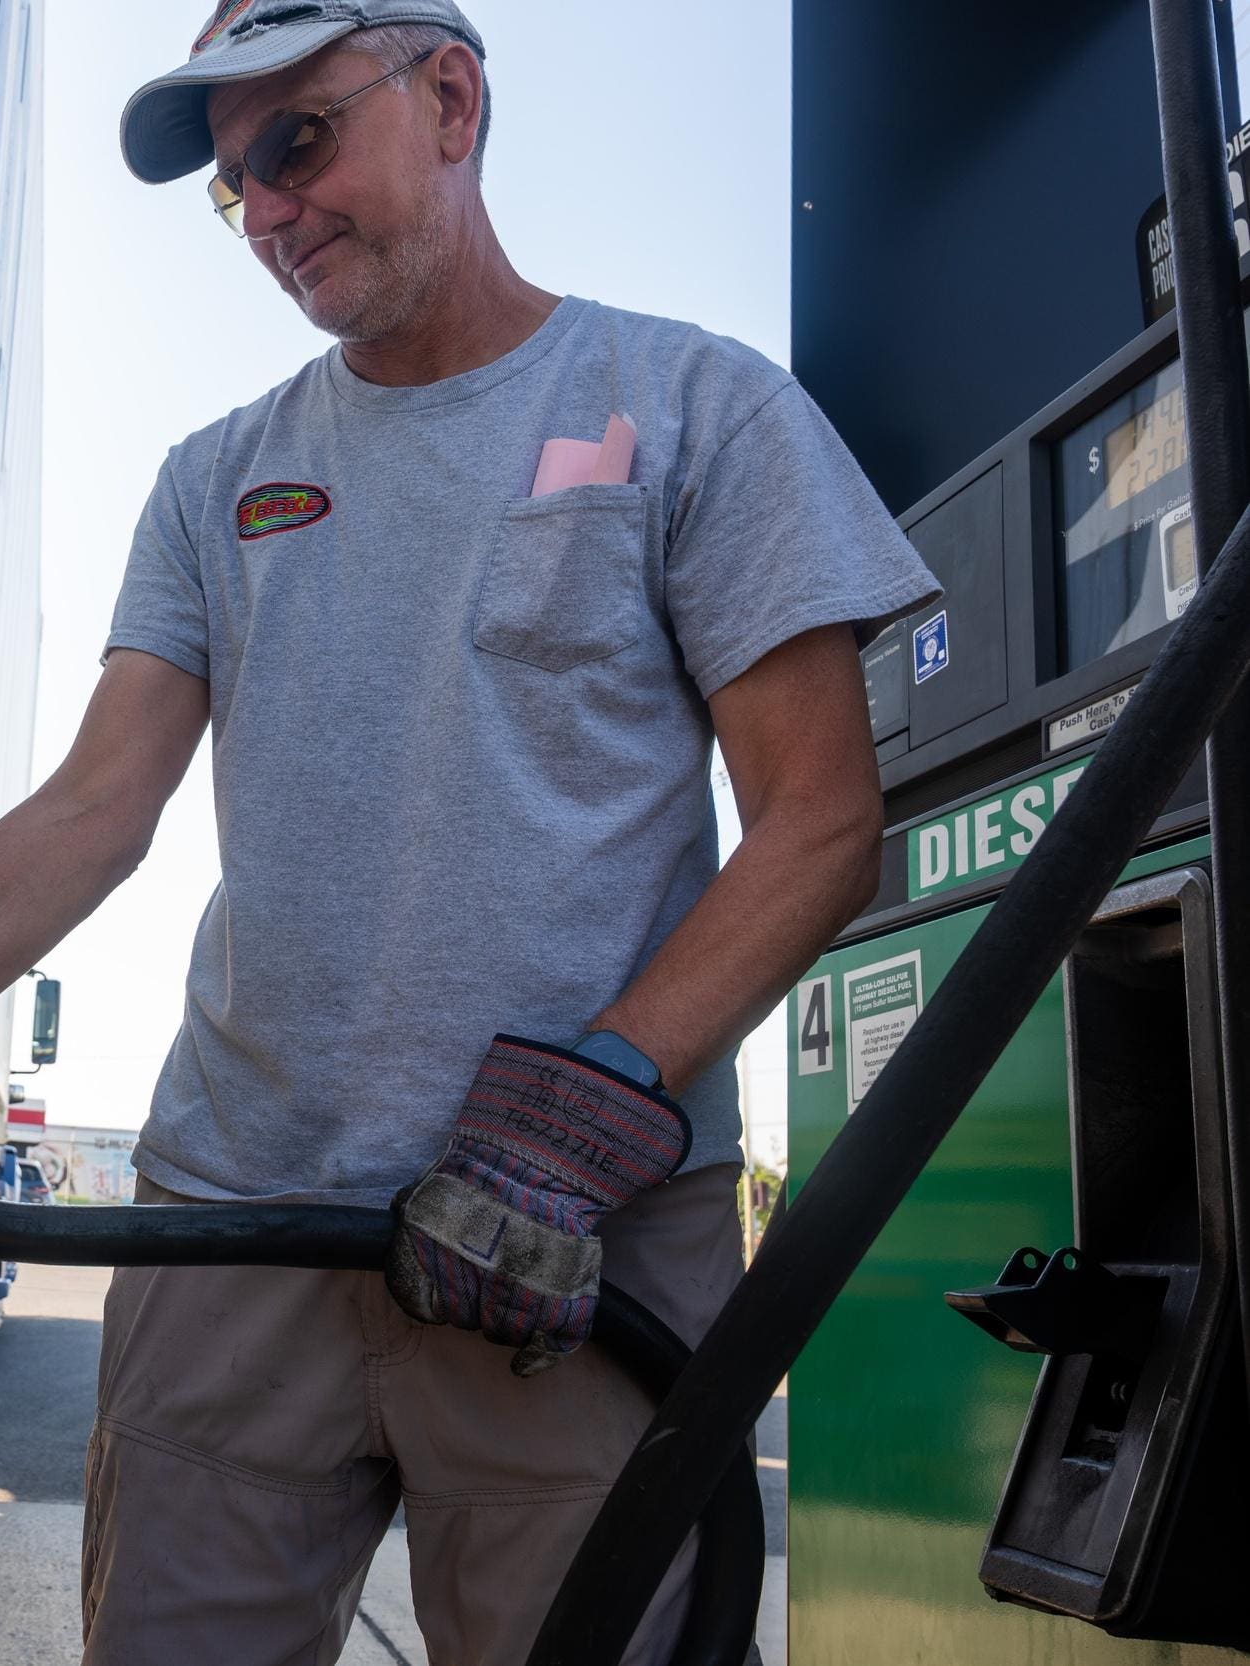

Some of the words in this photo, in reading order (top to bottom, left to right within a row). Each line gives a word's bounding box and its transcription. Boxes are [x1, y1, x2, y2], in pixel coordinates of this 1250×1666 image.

[1227, 122, 1250, 163] DIE
[1148, 216, 1171, 263] CAS
[1152, 255, 1174, 299] PRIC
[1088, 446, 1100, 475] $
[1178, 580, 1196, 597] Credi
[1059, 713, 1083, 731] Push
[1085, 702, 1110, 720] Here
[1112, 695, 1125, 708] To
[1089, 711, 1116, 731] Cash
[919, 766, 1085, 889] DIES
[800, 982, 831, 1067] 4
